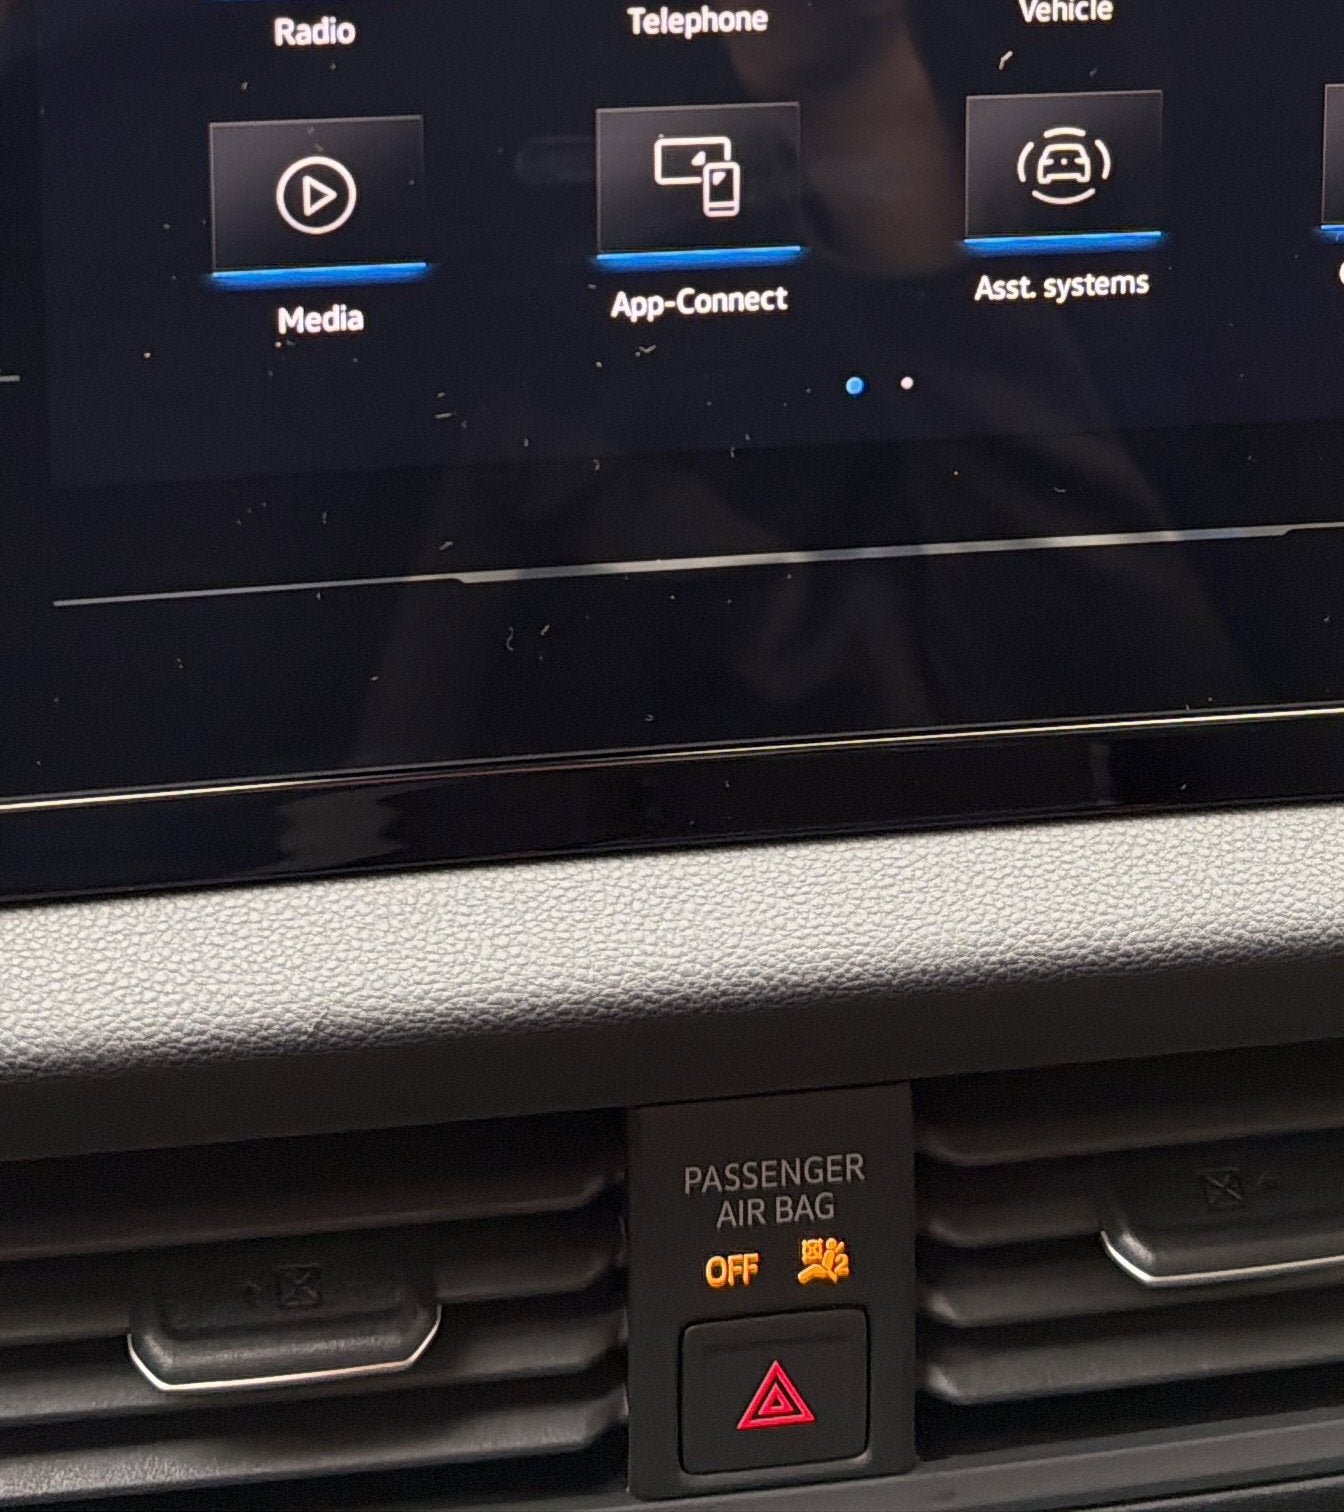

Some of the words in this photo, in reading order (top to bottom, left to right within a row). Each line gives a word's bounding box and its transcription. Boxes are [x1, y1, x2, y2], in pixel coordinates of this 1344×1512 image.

[274, 15, 357, 47] Radio
[626, 4, 769, 40] Telephone
[610, 286, 789, 323] App-Connect
[974, 273, 1037, 302] Asst.
[1043, 273, 1150, 305] systems
[277, 303, 365, 336] Media
[684, 1152, 866, 1195] PASSENGER
[716, 1197, 767, 1230] AIR
[775, 1191, 835, 1224] BAG
[705, 1252, 759, 1288] OFF
